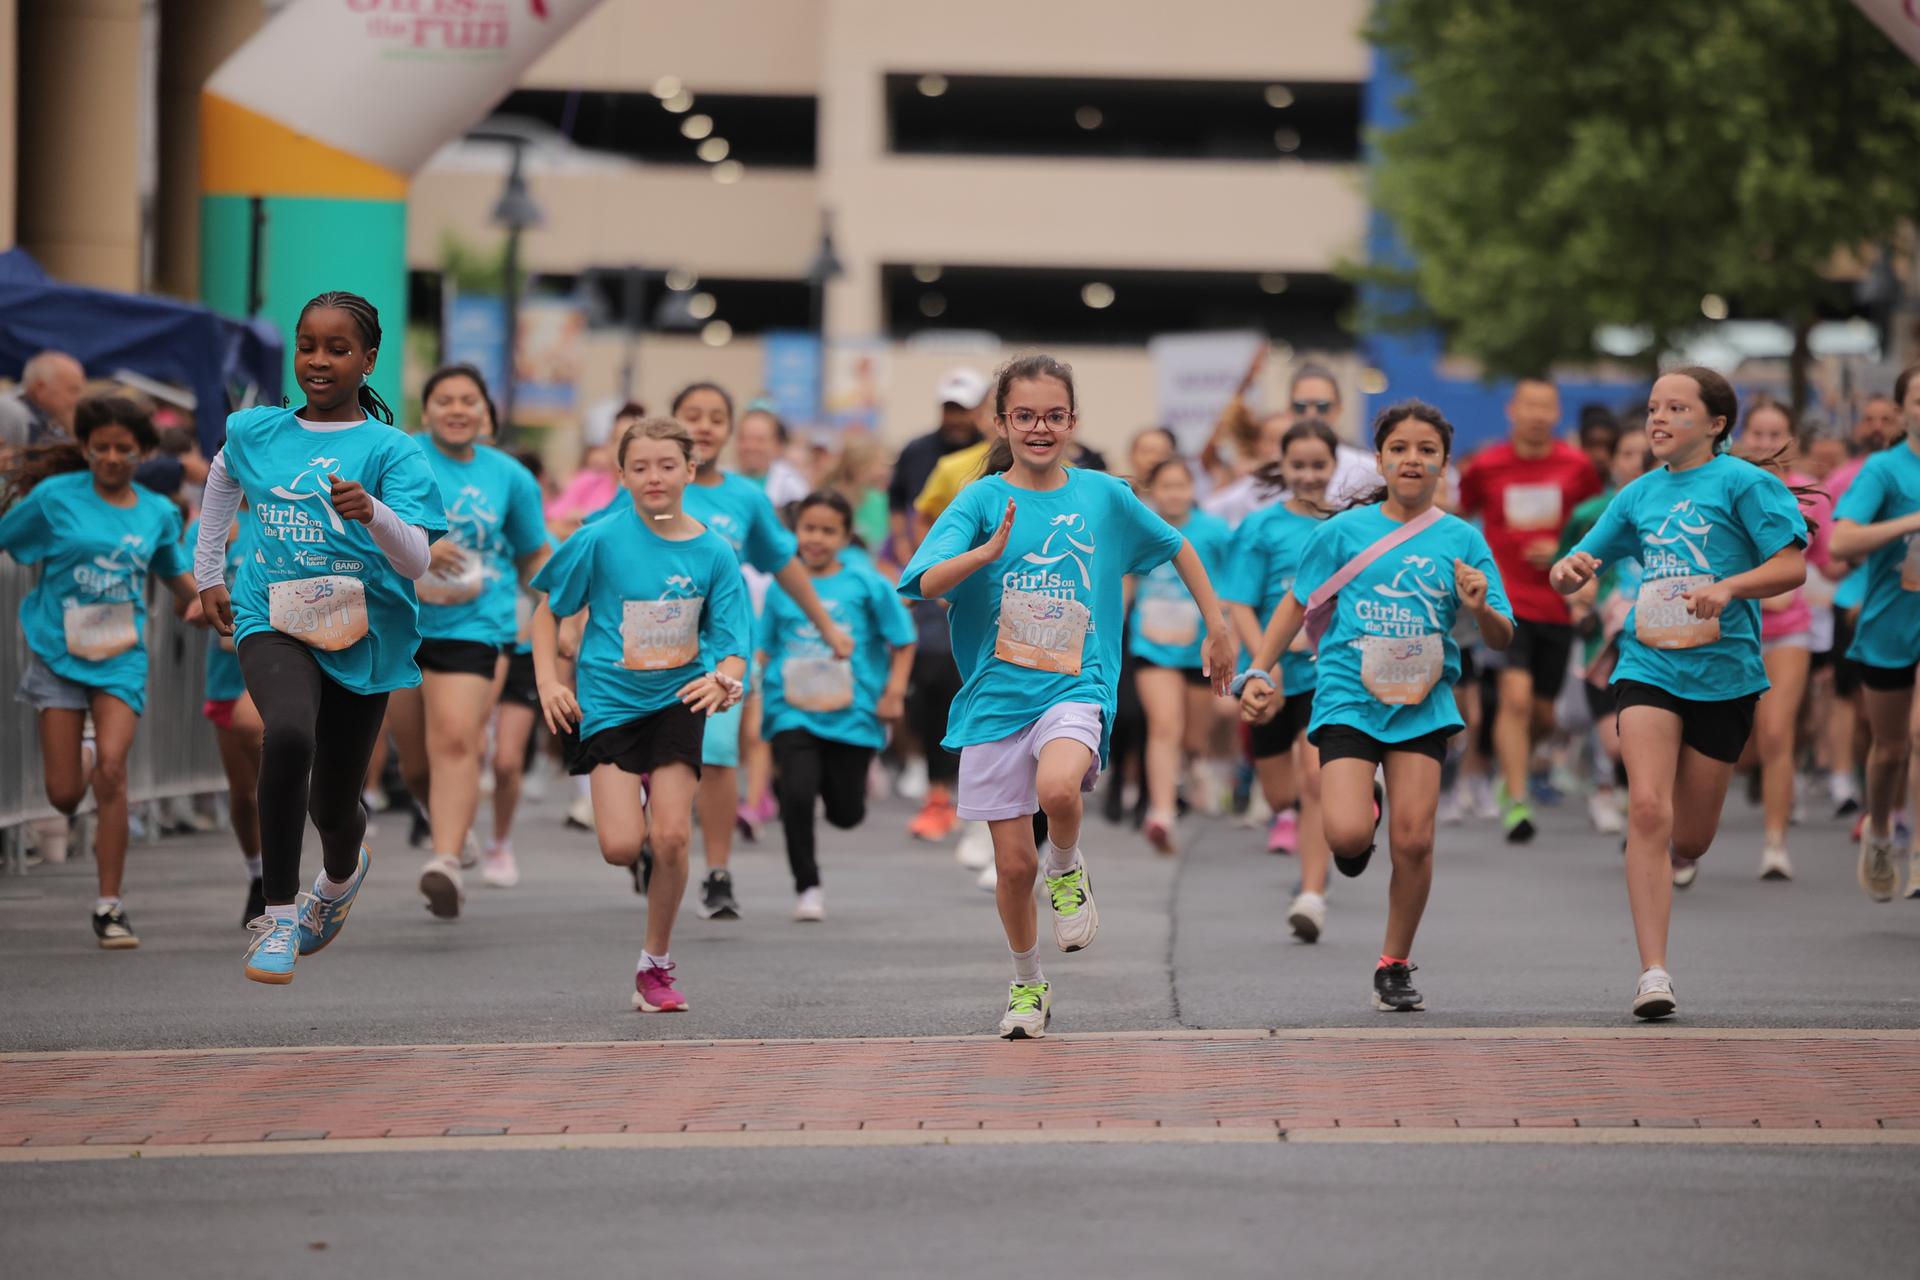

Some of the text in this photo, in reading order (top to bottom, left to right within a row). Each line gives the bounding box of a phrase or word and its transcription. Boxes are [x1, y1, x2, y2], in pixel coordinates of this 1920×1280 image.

[414, 19, 508, 47] run
[257, 503, 322, 527] Girls on
[264, 526, 326, 543] the run
[335, 562, 360, 571] BAND
[1002, 569, 1076, 590] Girls on
[315, 583, 333, 600] 25
[286, 601, 350, 634] 2911
[666, 607, 681, 619] 25
[1045, 605, 1065, 620] 25
[1355, 600, 1411, 622] Girls
[1648, 605, 1704, 629] 289
[1011, 620, 1072, 651] 3002
[1381, 621, 1424, 638] run
[1407, 644, 1423, 656] 25
